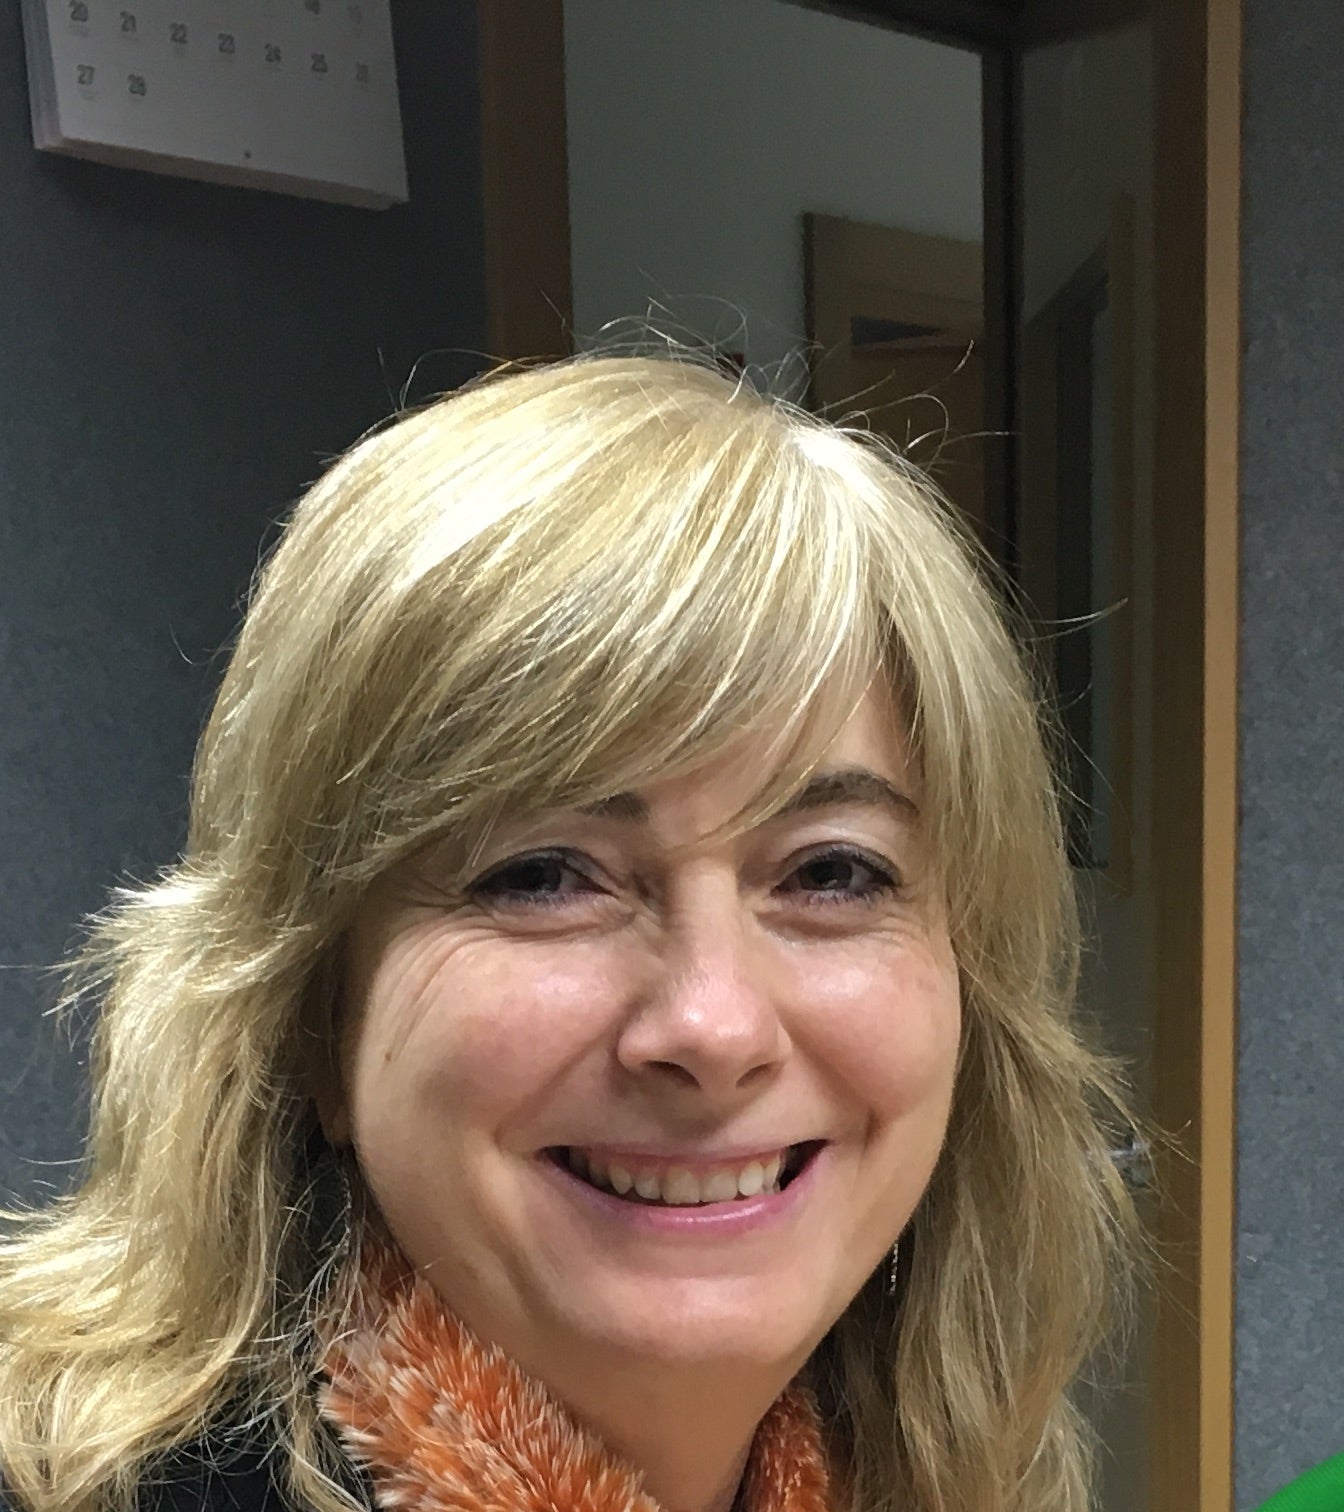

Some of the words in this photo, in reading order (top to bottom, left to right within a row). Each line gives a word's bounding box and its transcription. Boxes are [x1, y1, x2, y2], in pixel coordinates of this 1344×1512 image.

[169, 22, 188, 45] 22
[217, 33, 236, 54] 23
[264, 43, 282, 63] 24
[76, 64, 97, 85] 27
